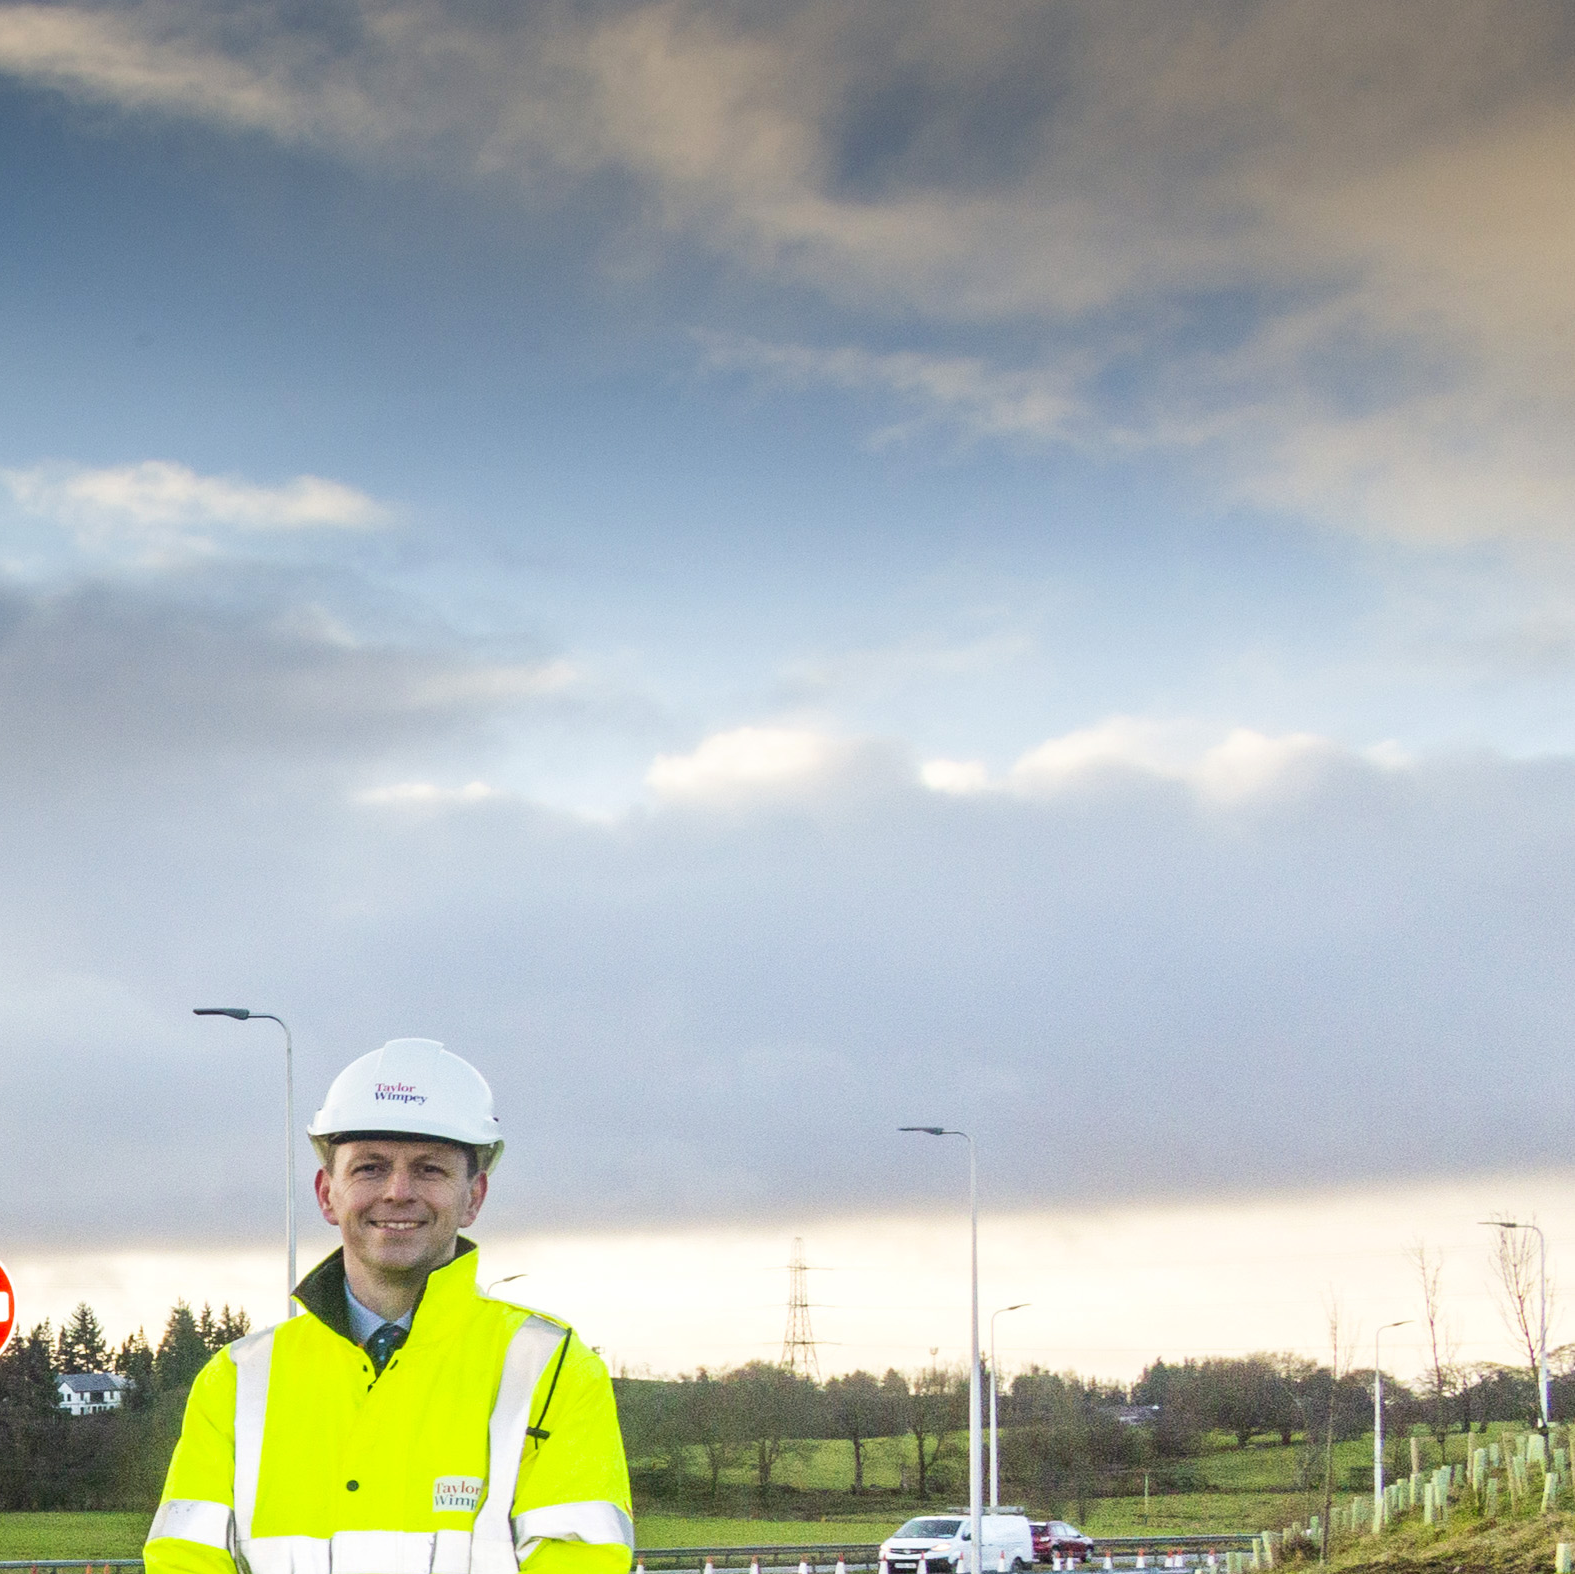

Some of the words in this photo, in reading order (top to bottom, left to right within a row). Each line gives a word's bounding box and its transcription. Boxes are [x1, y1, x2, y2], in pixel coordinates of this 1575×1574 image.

[375, 1082, 416, 1092] Taylor
[375, 1092, 427, 1105] Wimpey
[435, 1495, 478, 1510] Wimp
